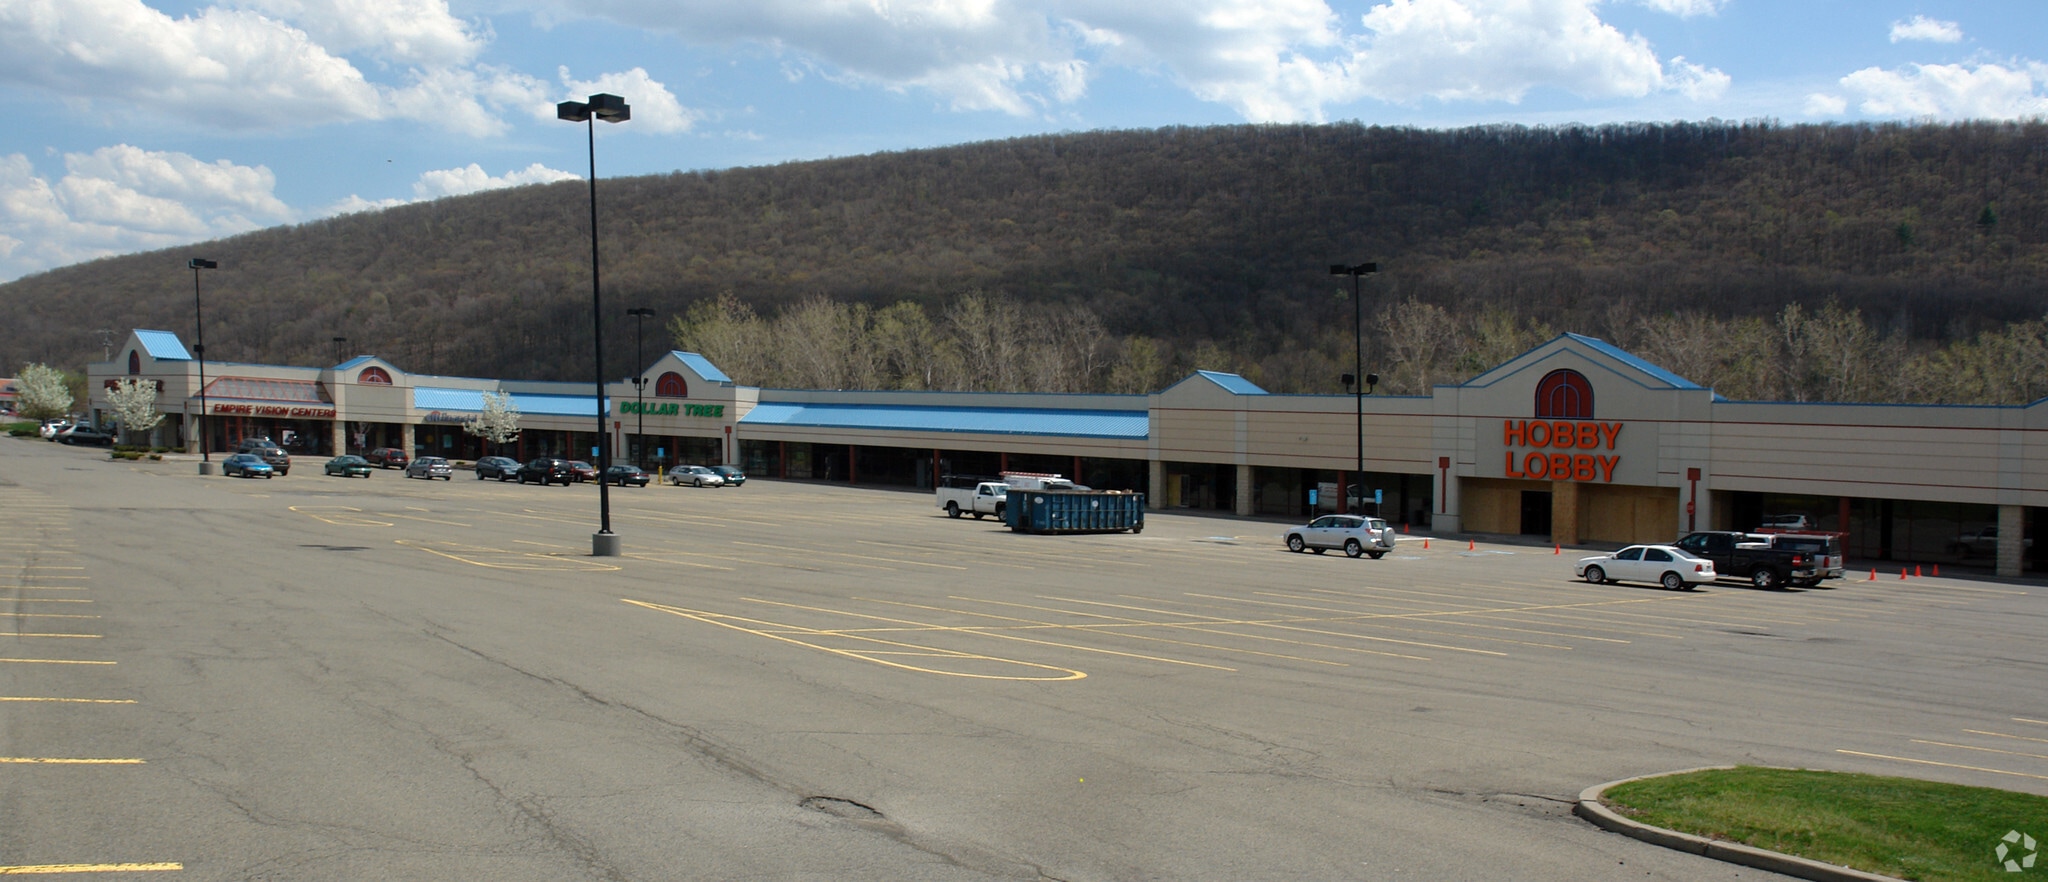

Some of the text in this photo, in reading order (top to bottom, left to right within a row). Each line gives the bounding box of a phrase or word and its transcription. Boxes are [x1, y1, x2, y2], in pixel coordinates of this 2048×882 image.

[213, 403, 337, 418] EMPIRE VISION CENTERS
[621, 401, 724, 417] DOLLAR TREE
[1504, 420, 1623, 450] HOBBY
[1505, 451, 1620, 483] LOBBY
